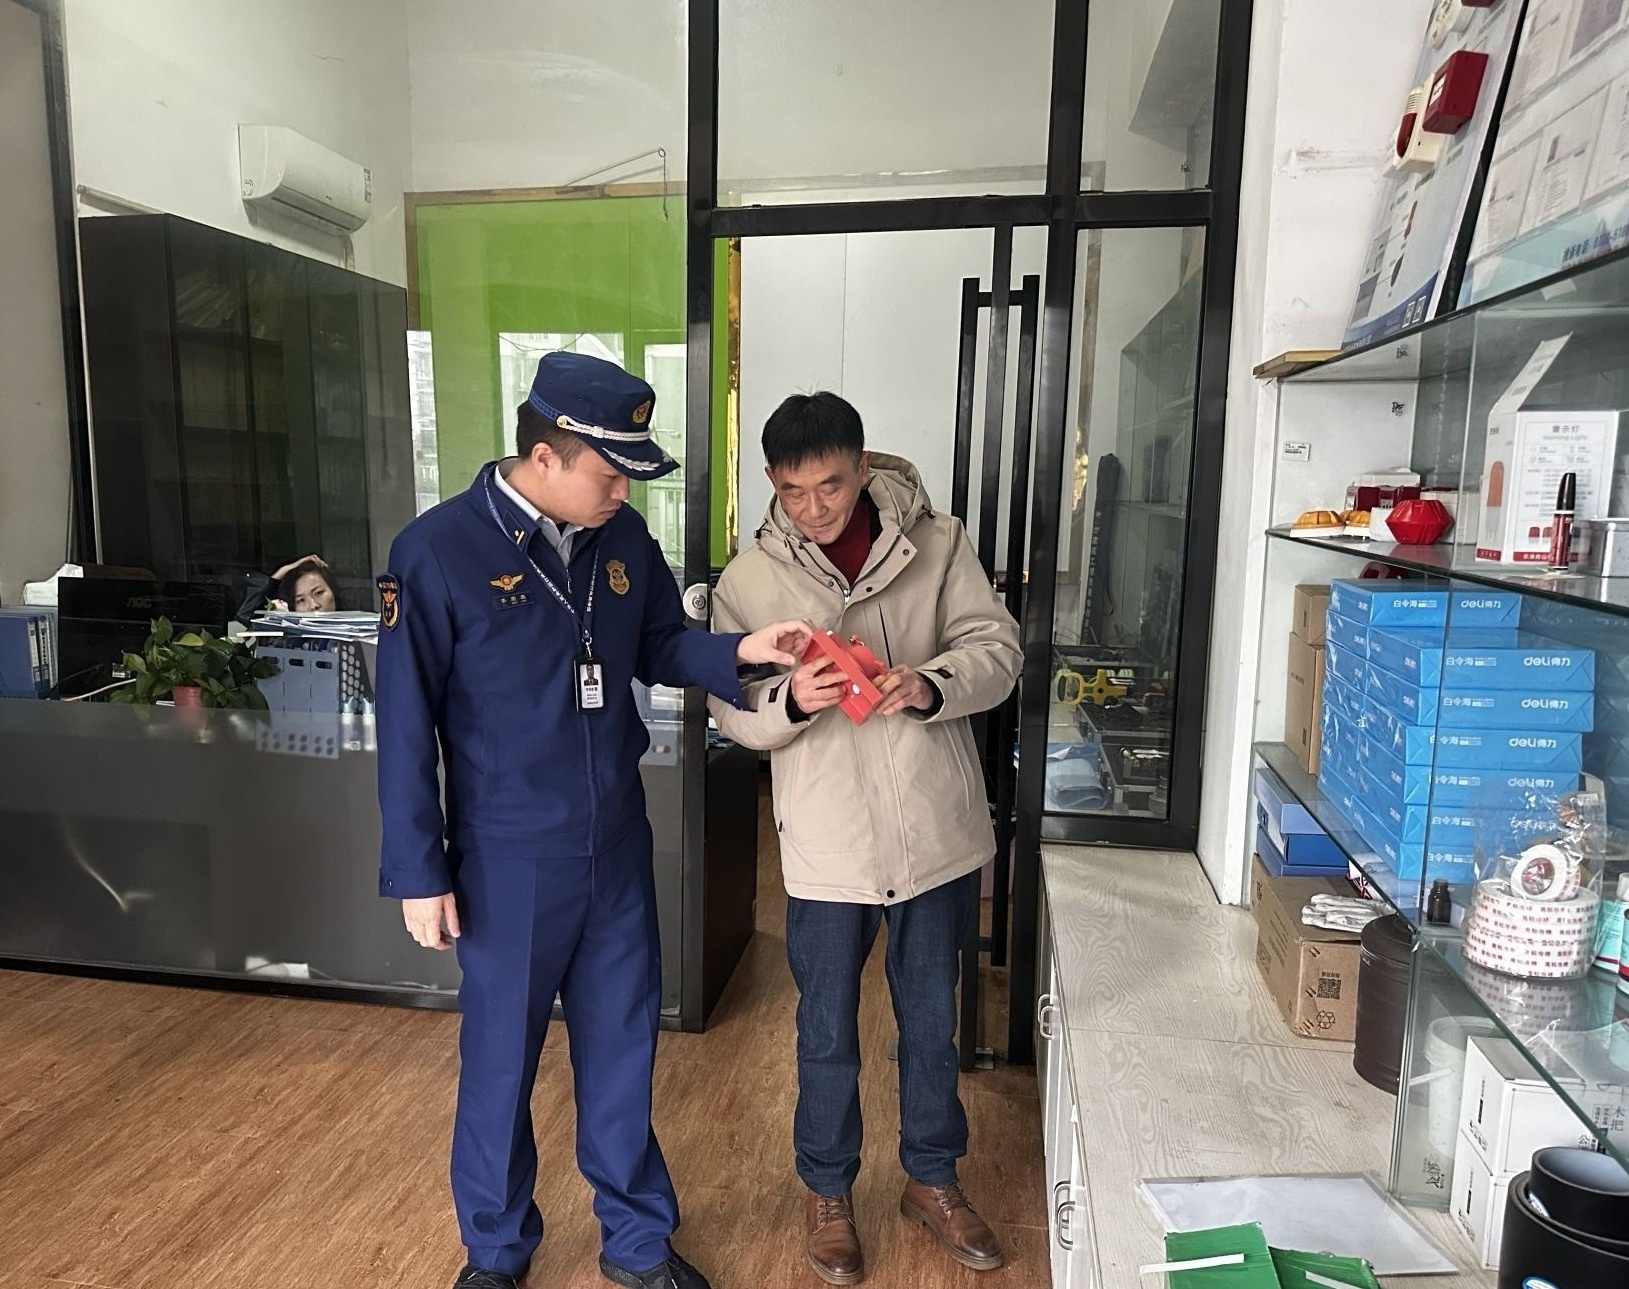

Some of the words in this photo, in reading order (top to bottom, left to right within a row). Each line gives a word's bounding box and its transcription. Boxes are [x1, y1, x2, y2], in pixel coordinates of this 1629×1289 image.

[1393, 599, 1418, 608] 白令海
[1446, 656, 1474, 667] 白令海
[1443, 697, 1472, 708] 白令海
[1432, 816, 1460, 826] 白令海
